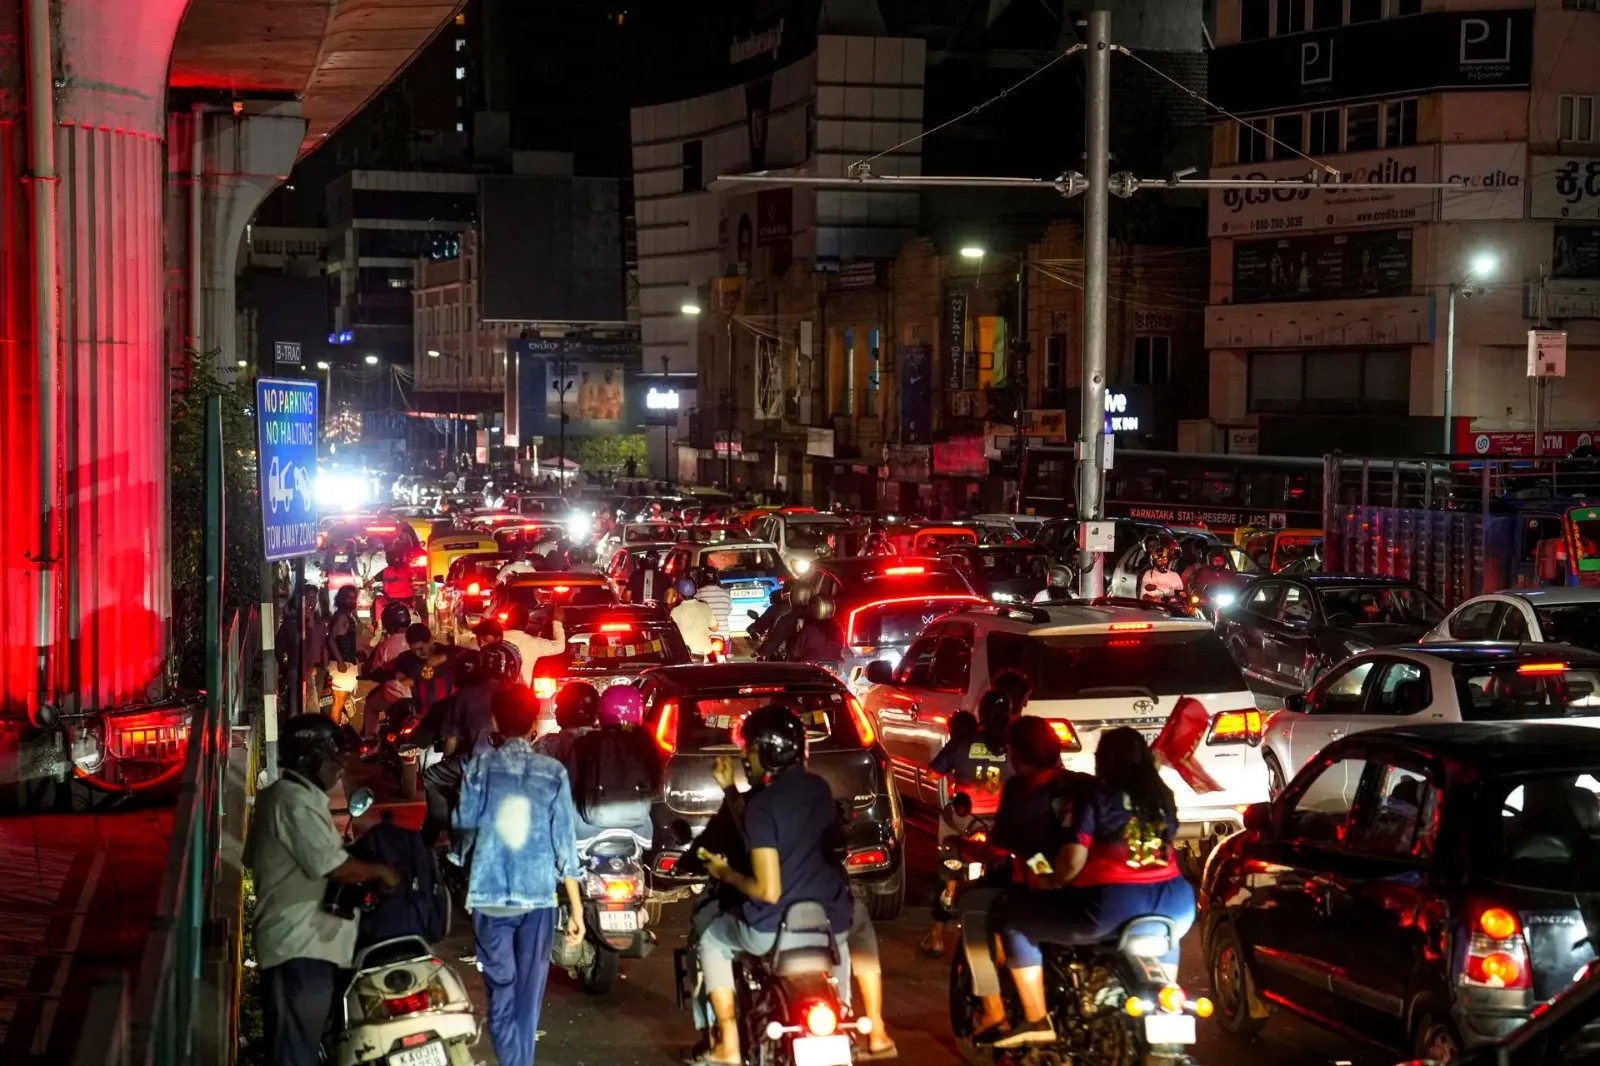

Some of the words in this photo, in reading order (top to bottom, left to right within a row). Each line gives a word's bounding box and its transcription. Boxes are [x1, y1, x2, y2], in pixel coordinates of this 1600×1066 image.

[1448, 170, 1519, 188] Credila
[276, 343, 300, 363] B-TRAC
[264, 389, 278, 413] NO
[279, 390, 313, 416] PARKING
[1104, 388, 1127, 413] ive
[266, 423, 279, 445] NO
[279, 423, 313, 445] HALTING
[1130, 508, 1174, 521] KARNATAKA
[1203, 511, 1237, 525] RESERVE
[267, 525, 282, 550] TOW
[282, 525, 298, 549] AWAY
[299, 525, 316, 545] ZONE
